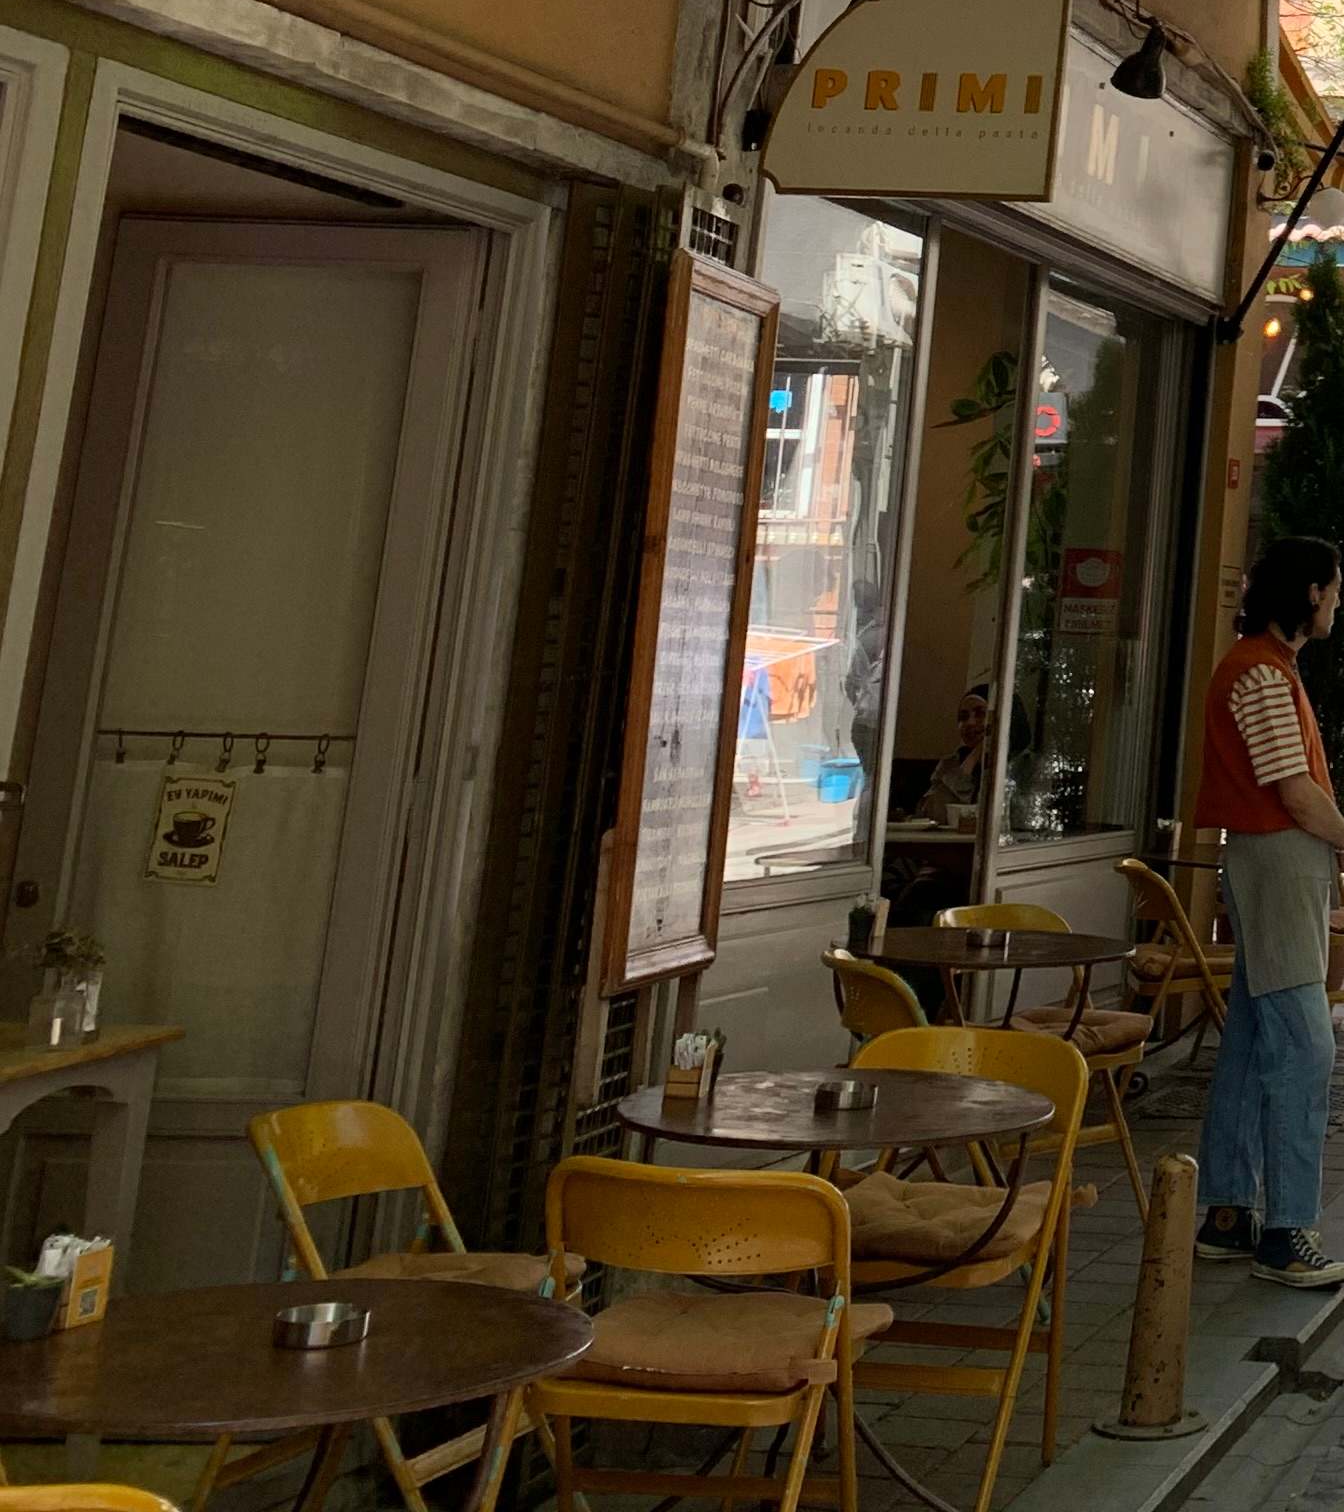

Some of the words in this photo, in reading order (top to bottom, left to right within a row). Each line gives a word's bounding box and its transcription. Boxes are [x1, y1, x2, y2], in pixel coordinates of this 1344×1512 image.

[811, 68, 1043, 114] PRIMI
[166, 790, 182, 803] EV
[186, 788, 229, 806] YAPIMI
[157, 851, 209, 870] SALEP
